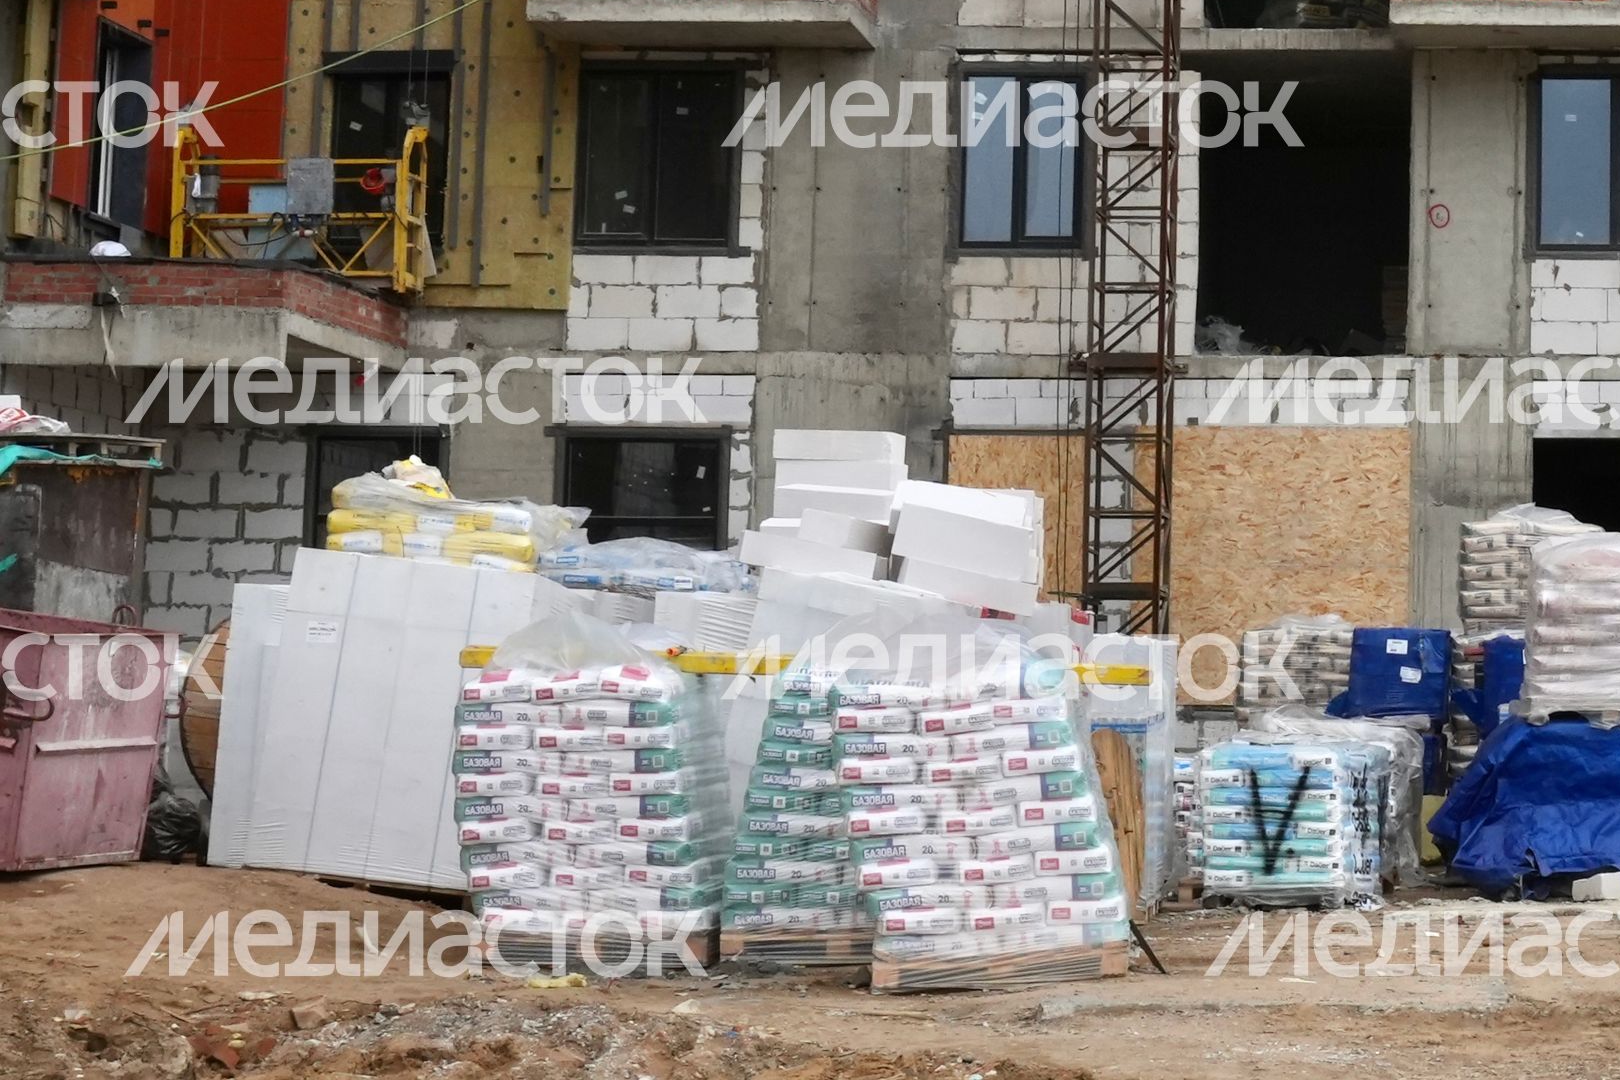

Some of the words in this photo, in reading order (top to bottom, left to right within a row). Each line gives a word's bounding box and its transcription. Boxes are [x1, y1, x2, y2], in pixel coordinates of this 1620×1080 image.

[840, 695, 880, 706] БАЗОВАЯ
[463, 711, 502, 721] БАЗОВАЯ
[775, 727, 814, 740] БАЗОВАЯ
[844, 743, 887, 754] БАЗОВАЯ
[463, 758, 502, 768] БАЗОВАЯ
[763, 774, 801, 786] БАЗОВАЯ
[852, 795, 894, 807] БАЗОВАЯ
[464, 804, 503, 815] БАЗОВАЯ
[749, 821, 788, 833] БАЗОВАЯ
[470, 852, 510, 863] БАЗОВАЯ
[863, 846, 906, 859] БАЗОВАЯ
[737, 869, 776, 879] БАЗОВАЯ
[879, 896, 922, 910] БАЗОВАЯ
[734, 914, 773, 925] БАЗОВАЯ
